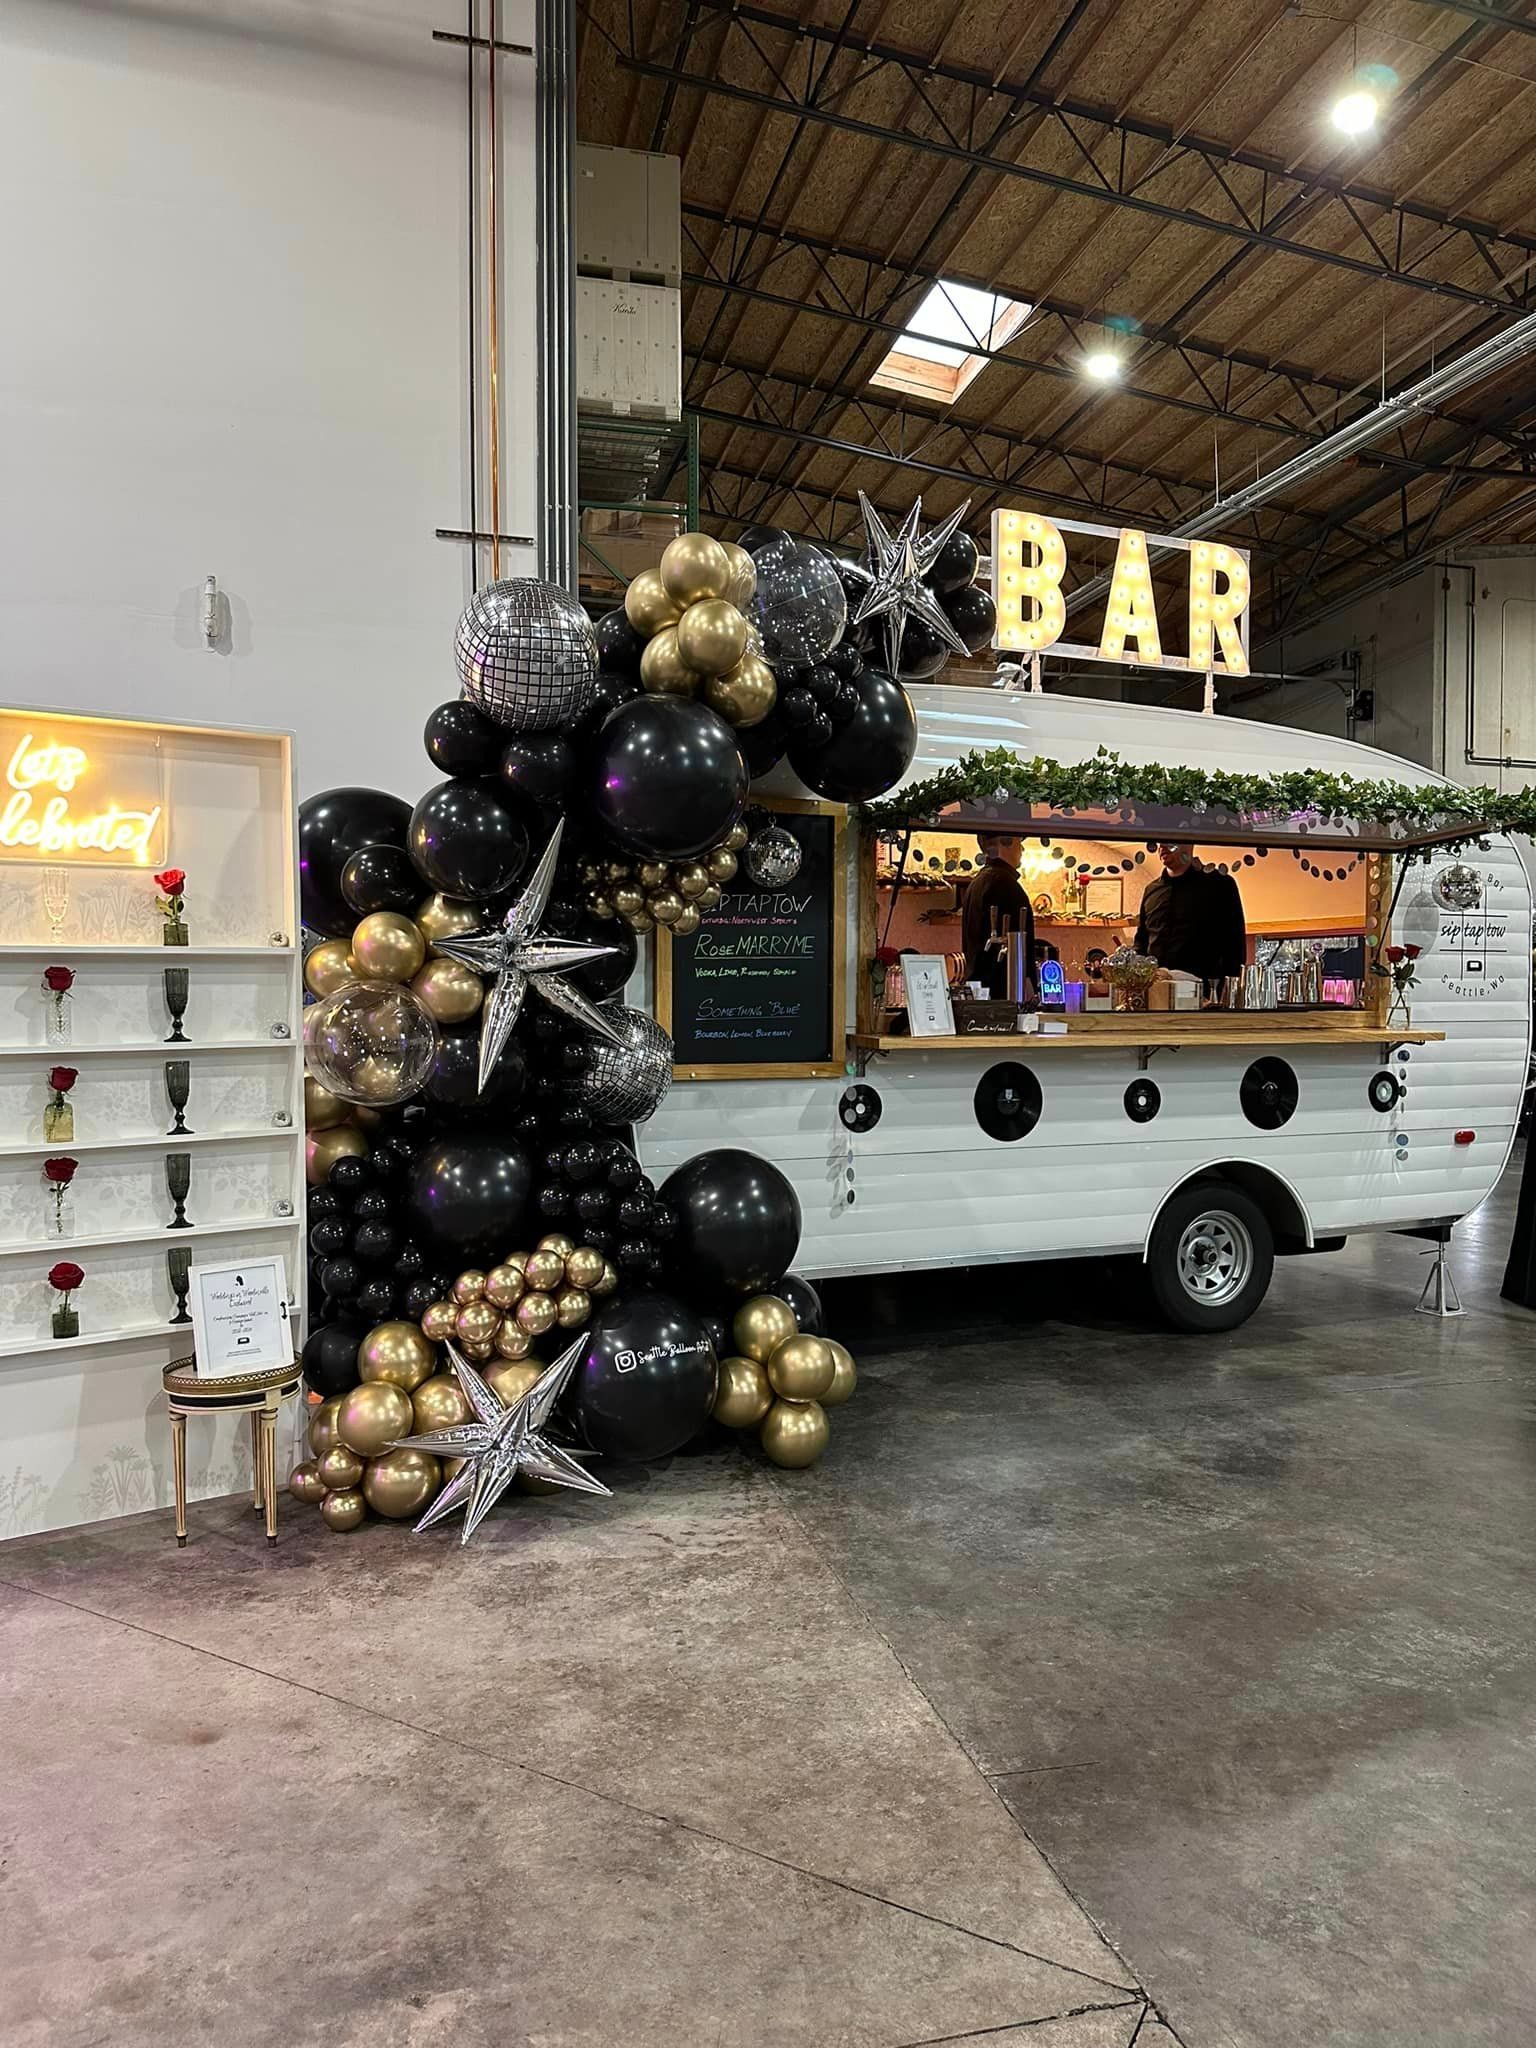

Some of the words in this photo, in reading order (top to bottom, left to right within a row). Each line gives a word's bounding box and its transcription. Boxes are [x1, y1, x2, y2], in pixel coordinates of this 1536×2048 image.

[991, 508, 1251, 677] BAR
[1440, 920, 1461, 945] sip
[1463, 922, 1484, 946] tap
[1486, 922, 1506, 938] tow
[1044, 983, 1062, 993] BAR
[637, 1345, 668, 1364] Seattle
[667, 1343, 697, 1357] Balloon
